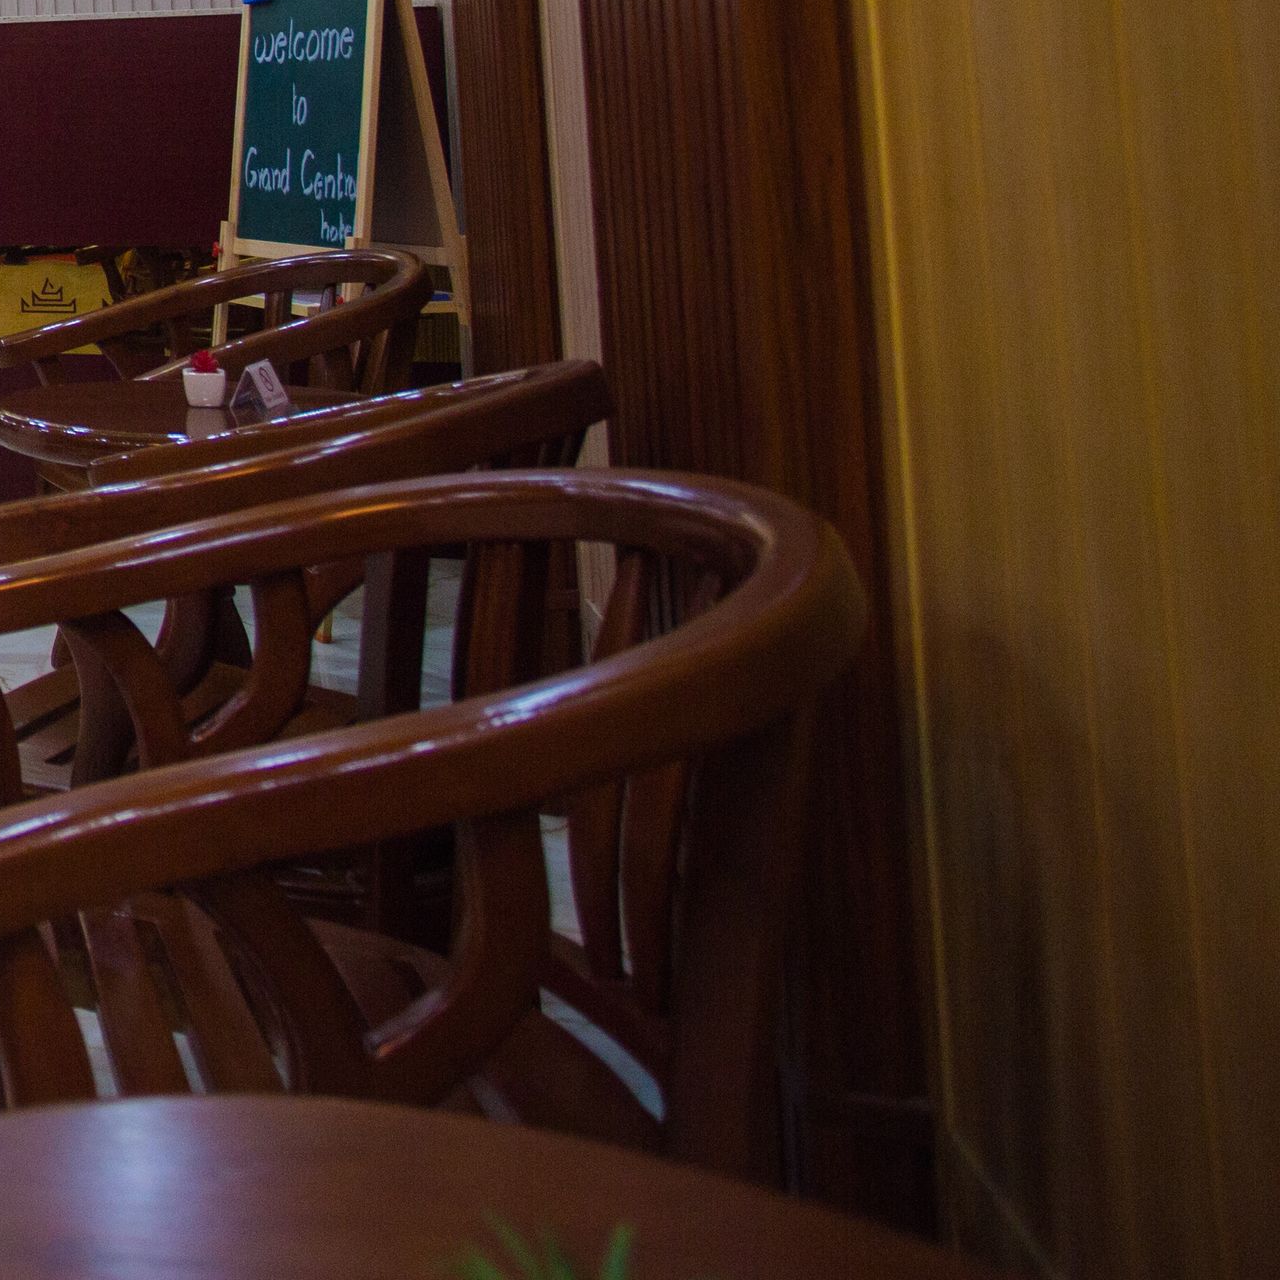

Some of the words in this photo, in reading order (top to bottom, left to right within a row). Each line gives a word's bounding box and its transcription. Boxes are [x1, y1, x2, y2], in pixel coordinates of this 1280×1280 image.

[254, 19, 354, 64] welcome
[292, 82, 308, 125] to
[244, 146, 290, 195] Grand
[301, 148, 357, 201] Centra
